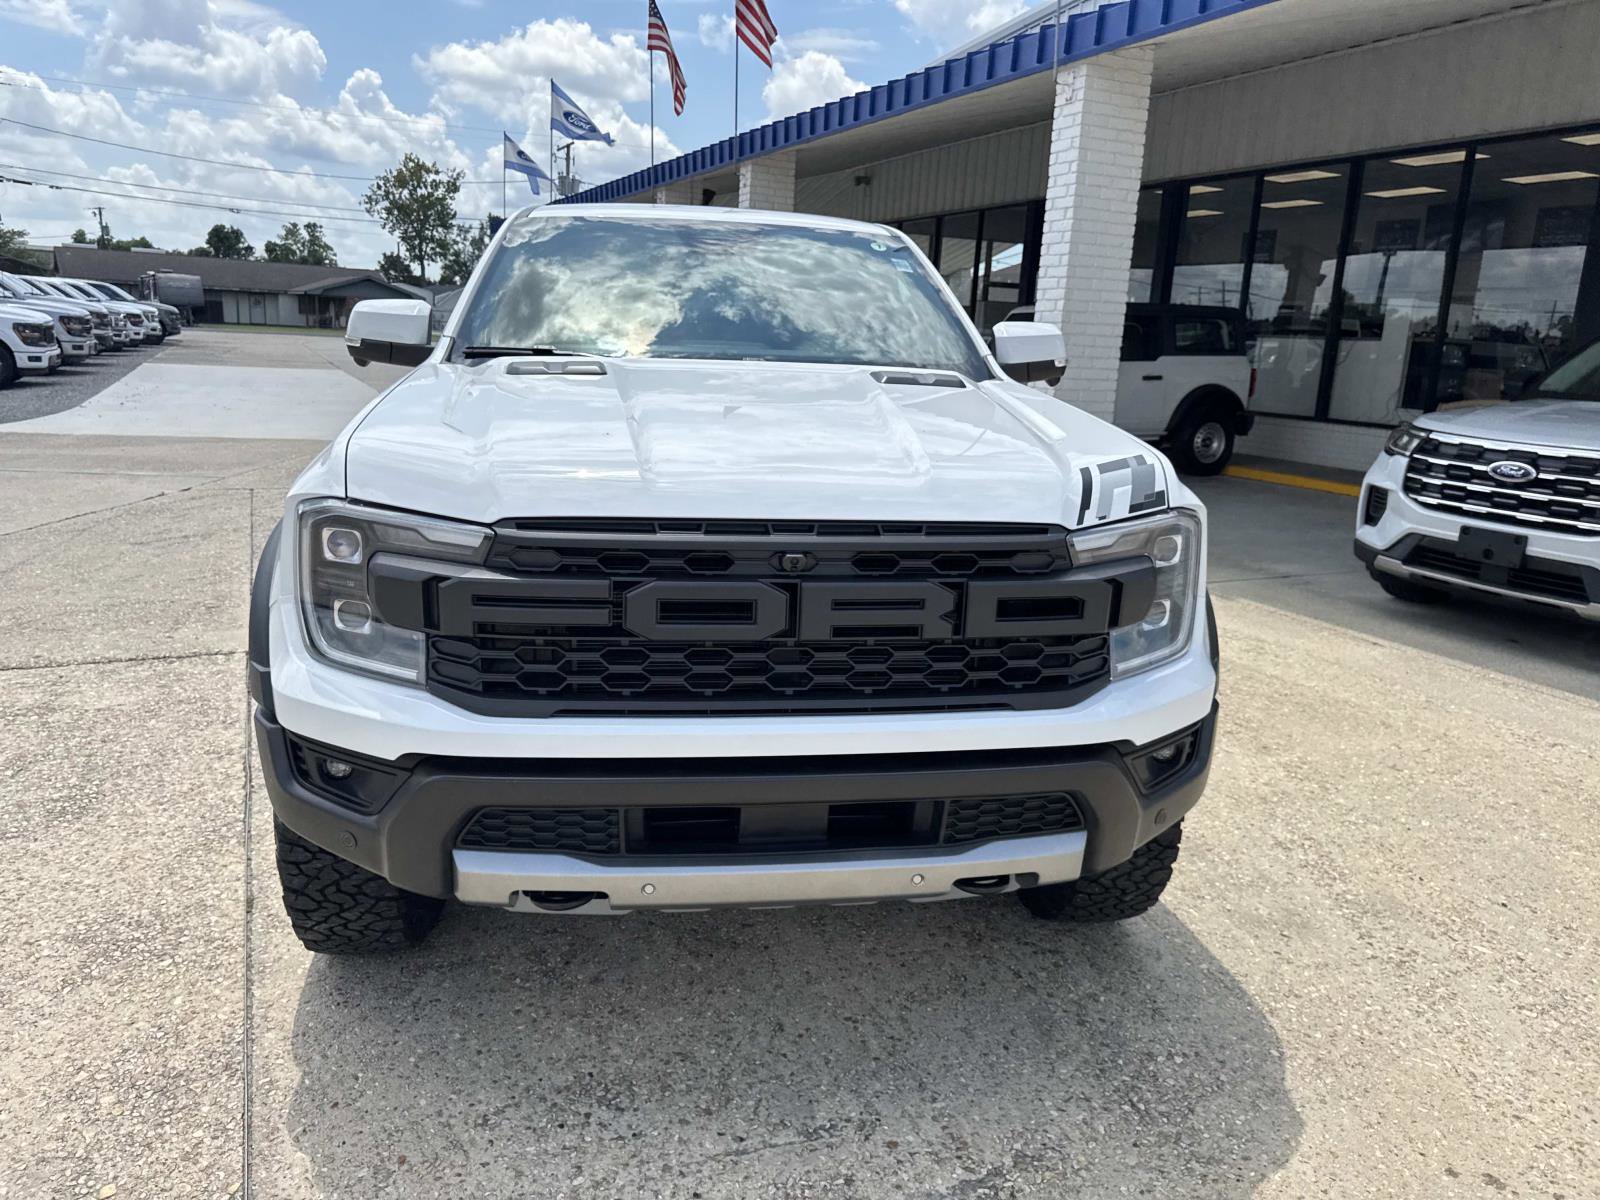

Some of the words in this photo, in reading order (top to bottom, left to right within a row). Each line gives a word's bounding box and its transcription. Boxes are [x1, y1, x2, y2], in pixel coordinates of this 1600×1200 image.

[568, 113, 591, 130] Ford
[1497, 465, 1525, 477] Ford
[438, 577, 1114, 641] FORD
